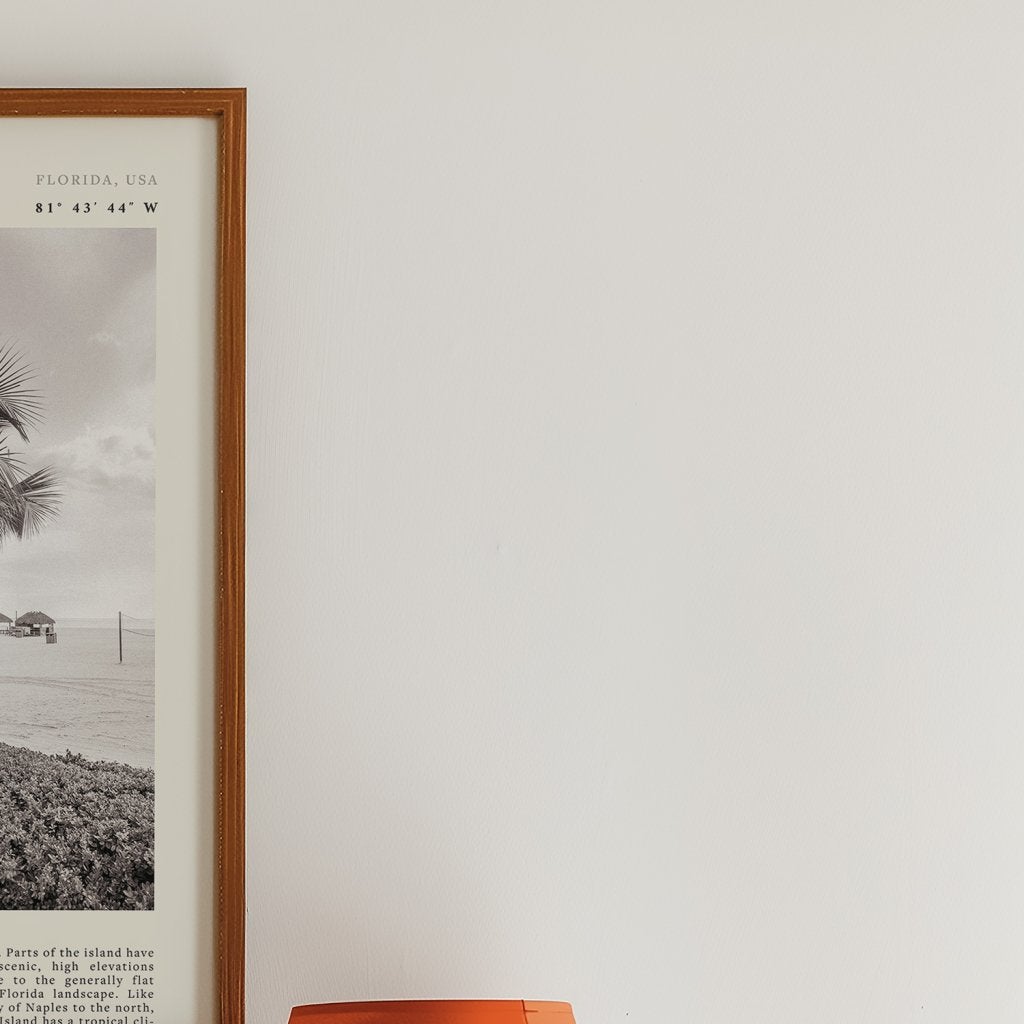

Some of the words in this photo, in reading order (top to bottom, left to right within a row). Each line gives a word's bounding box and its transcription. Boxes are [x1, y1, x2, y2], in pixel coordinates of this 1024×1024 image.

[37, 175, 118, 187] FLORIDA,
[126, 175, 157, 185] USA
[36, 203, 62, 213] 81°
[144, 202, 158, 213] W
[6, 948, 39, 958] Parts
[43, 948, 56, 958] of
[59, 948, 80, 958] the
[84, 948, 122, 958] island
[126, 948, 154, 958] have
[52, 961, 79, 975] high
[89, 961, 154, 972] elevations
[13, 976, 26, 985] to
[35, 975, 55, 985] the
[64, 975, 123, 988] generally
[132, 975, 154, 985] flat
[0, 989, 44, 999] Florida
[53, 989, 119, 1002] landscape.
[127, 989, 154, 999] Like
